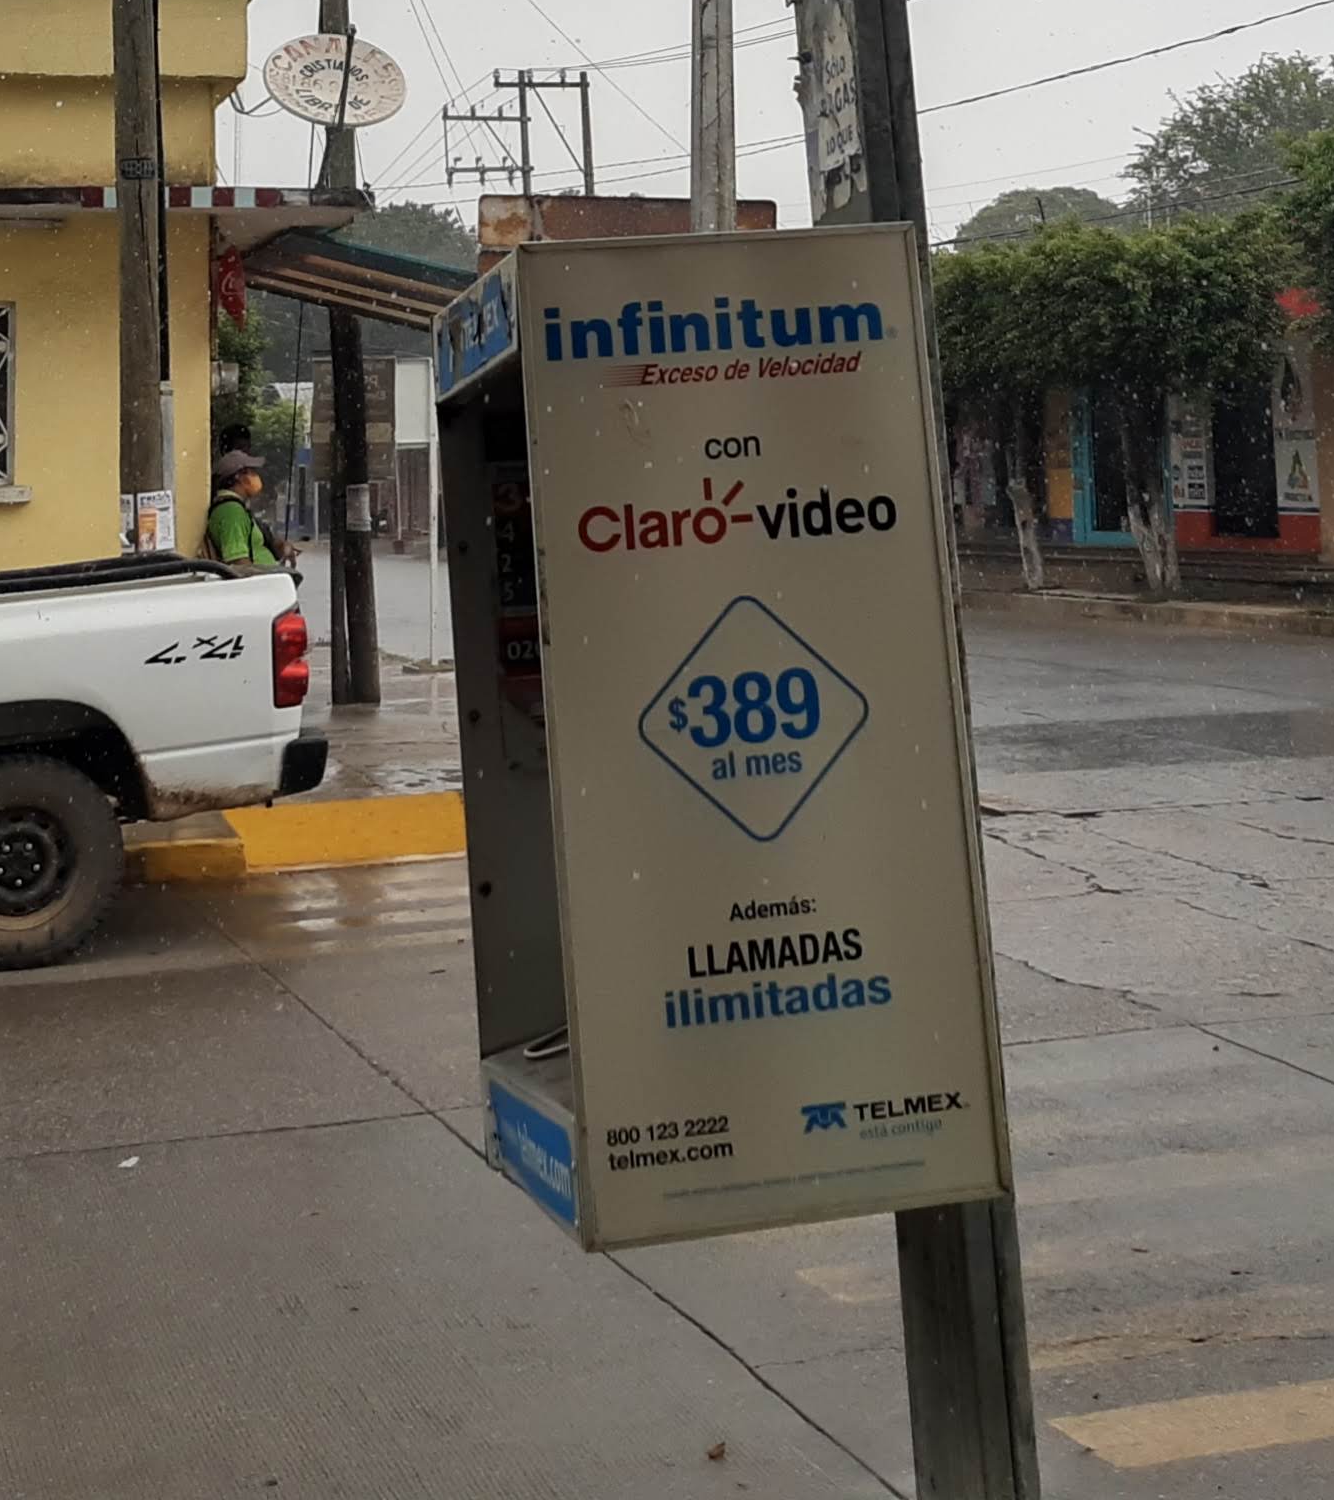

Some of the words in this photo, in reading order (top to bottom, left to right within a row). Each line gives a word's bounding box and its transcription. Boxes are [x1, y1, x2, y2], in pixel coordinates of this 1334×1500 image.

[272, 37, 396, 77] CANAES
[544, 297, 883, 361] infinitum
[641, 362, 718, 386] Exceso
[724, 359, 750, 381] de
[758, 351, 862, 378] Velocidad
[704, 435, 762, 460] con
[578, 503, 728, 553] Claro
[756, 487, 898, 540] video
[669, 667, 820, 748] $389
[713, 751, 737, 780] al
[745, 751, 803, 777] mes
[729, 895, 818, 922] Además:
[687, 928, 864, 978] LLAMADAS
[664, 972, 893, 1029] ilimitadas
[854, 1092, 963, 1122] TELMEX
[606, 1127, 641, 1147] 800
[647, 1122, 680, 1142] 123
[684, 1115, 730, 1138] 2222
[607, 1141, 734, 1171] telmex.com
